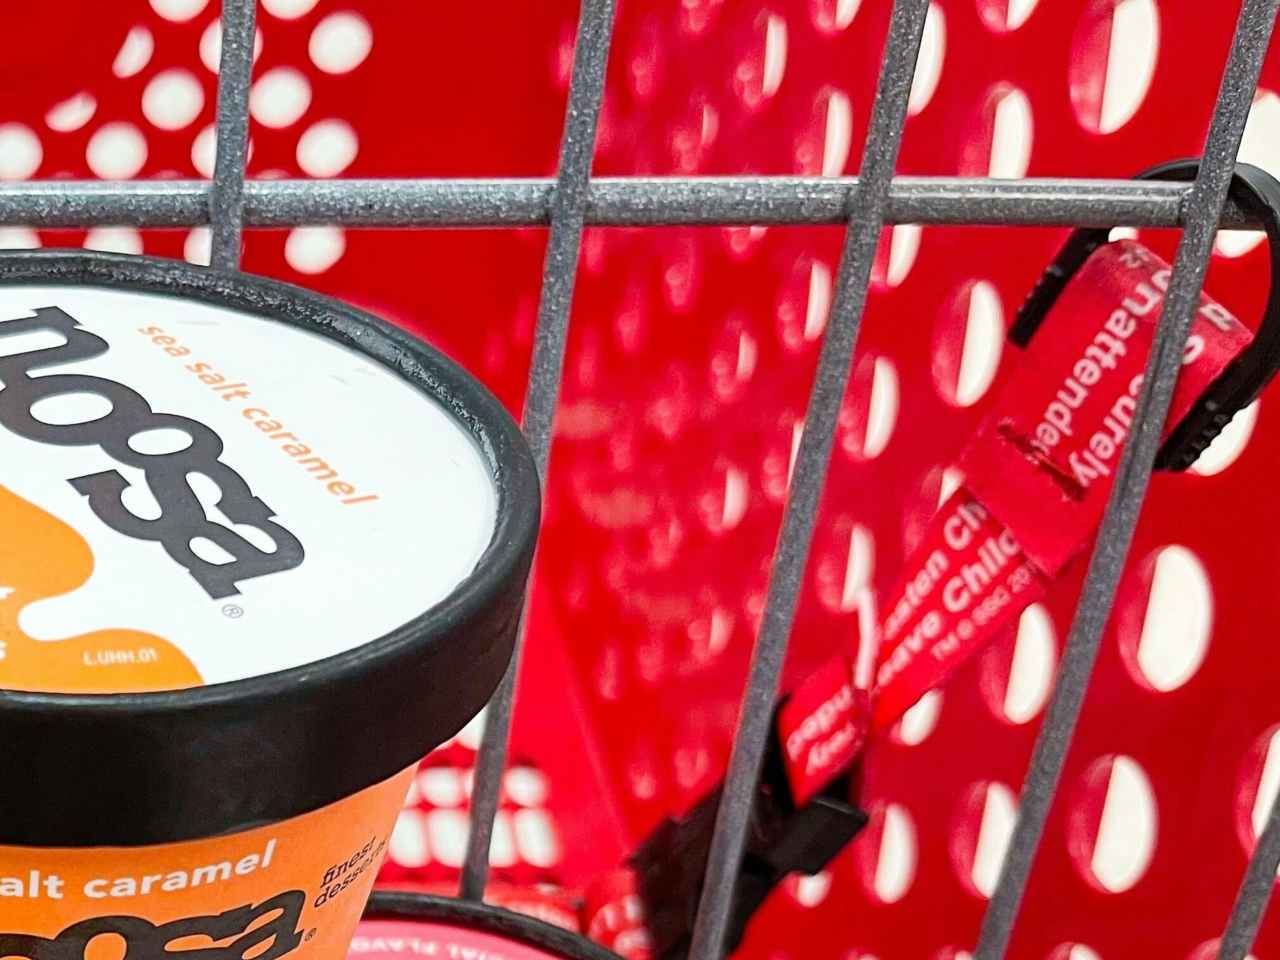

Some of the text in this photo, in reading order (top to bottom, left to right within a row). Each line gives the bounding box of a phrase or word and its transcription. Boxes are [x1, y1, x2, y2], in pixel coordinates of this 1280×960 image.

[137, 323, 380, 506] sea salt caramel
[84, 839, 277, 900] caramel
[350, 935, 439, 957] FLAVO
